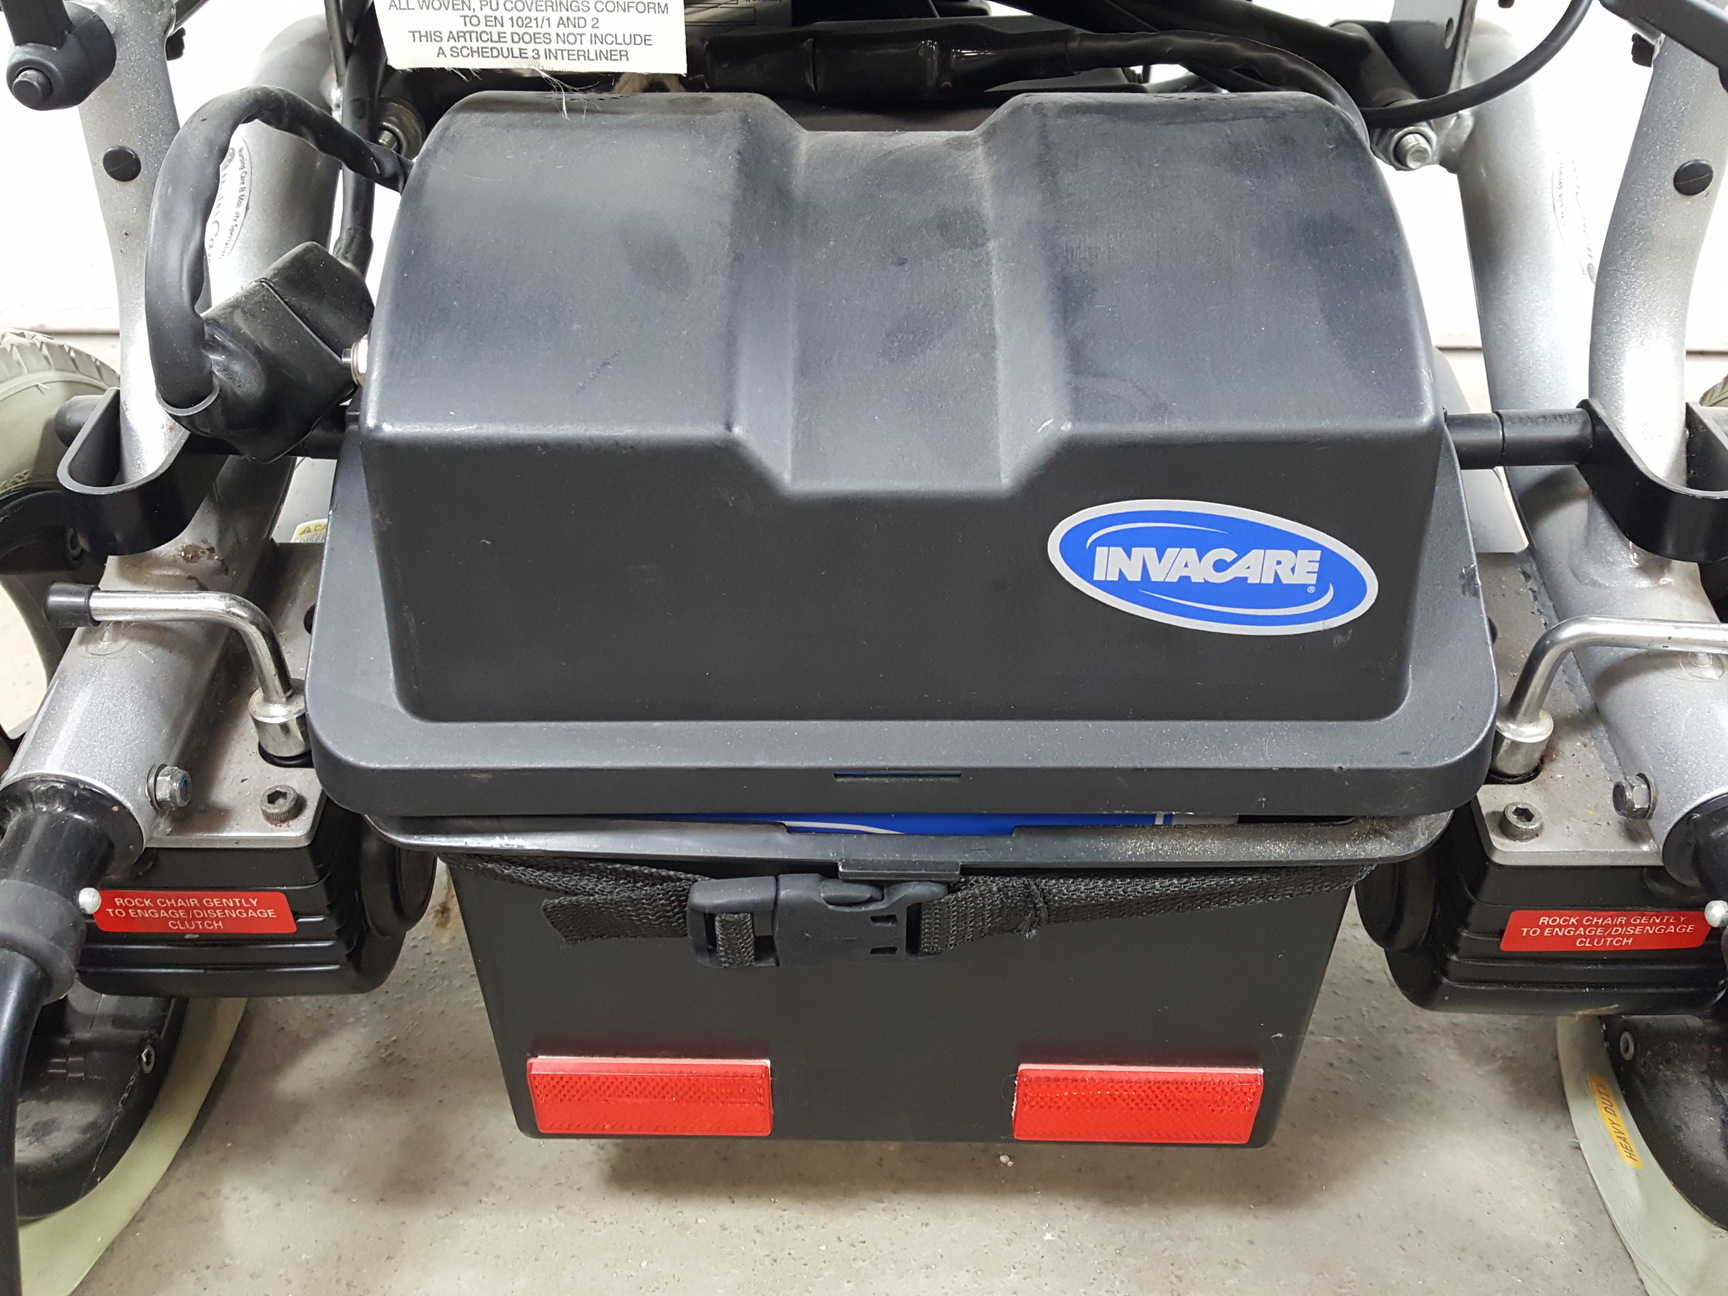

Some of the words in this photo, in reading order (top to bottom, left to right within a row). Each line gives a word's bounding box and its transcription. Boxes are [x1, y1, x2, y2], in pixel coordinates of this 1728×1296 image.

[389, 0, 415, 11] ALL
[418, 0, 475, 13] WOVEN,
[480, 0, 500, 12] PU
[503, 0, 590, 13] COVERINGS
[594, 1, 669, 14] CONFORM
[460, 15, 481, 28] TO
[484, 16, 505, 28] EN
[508, 16, 552, 29] 1021/1
[557, 17, 587, 29] AND
[590, 17, 600, 29] 2
[408, 30, 446, 43] THIS
[448, 31, 508, 44] ARTICLE
[511, 32, 552, 45] DOES
[556, 33, 587, 45] NOT
[590, 33, 653, 46] INCLUDE
[436, 47, 447, 59] A
[450, 47, 529, 60] SCHEDULE
[531, 48, 541, 60] 3
[544, 48, 630, 62] INTERLINER
[239, 171, 248, 185] Care
[1093, 546, 1321, 585] INVACARE
[114, 898, 154, 907] ROCK
[157, 898, 200, 907] CHAIR
[203, 898, 258, 907] GENTLY
[106, 908, 126, 917] TO
[130, 909, 277, 918] ENGAGE/DISENGAGE
[1538, 916, 1579, 925] ROCK
[1582, 916, 1627, 925] CHAIR
[1630, 915, 1688, 924] GENTLY
[168, 920, 224, 930] CLUTCH
[1521, 927, 1541, 937] TO
[1543, 924, 1696, 936] ENGAGE/DISENGAGE
[1575, 937, 1633, 947] CLUTCH
[1607, 1117, 1638, 1162] HEAVY
